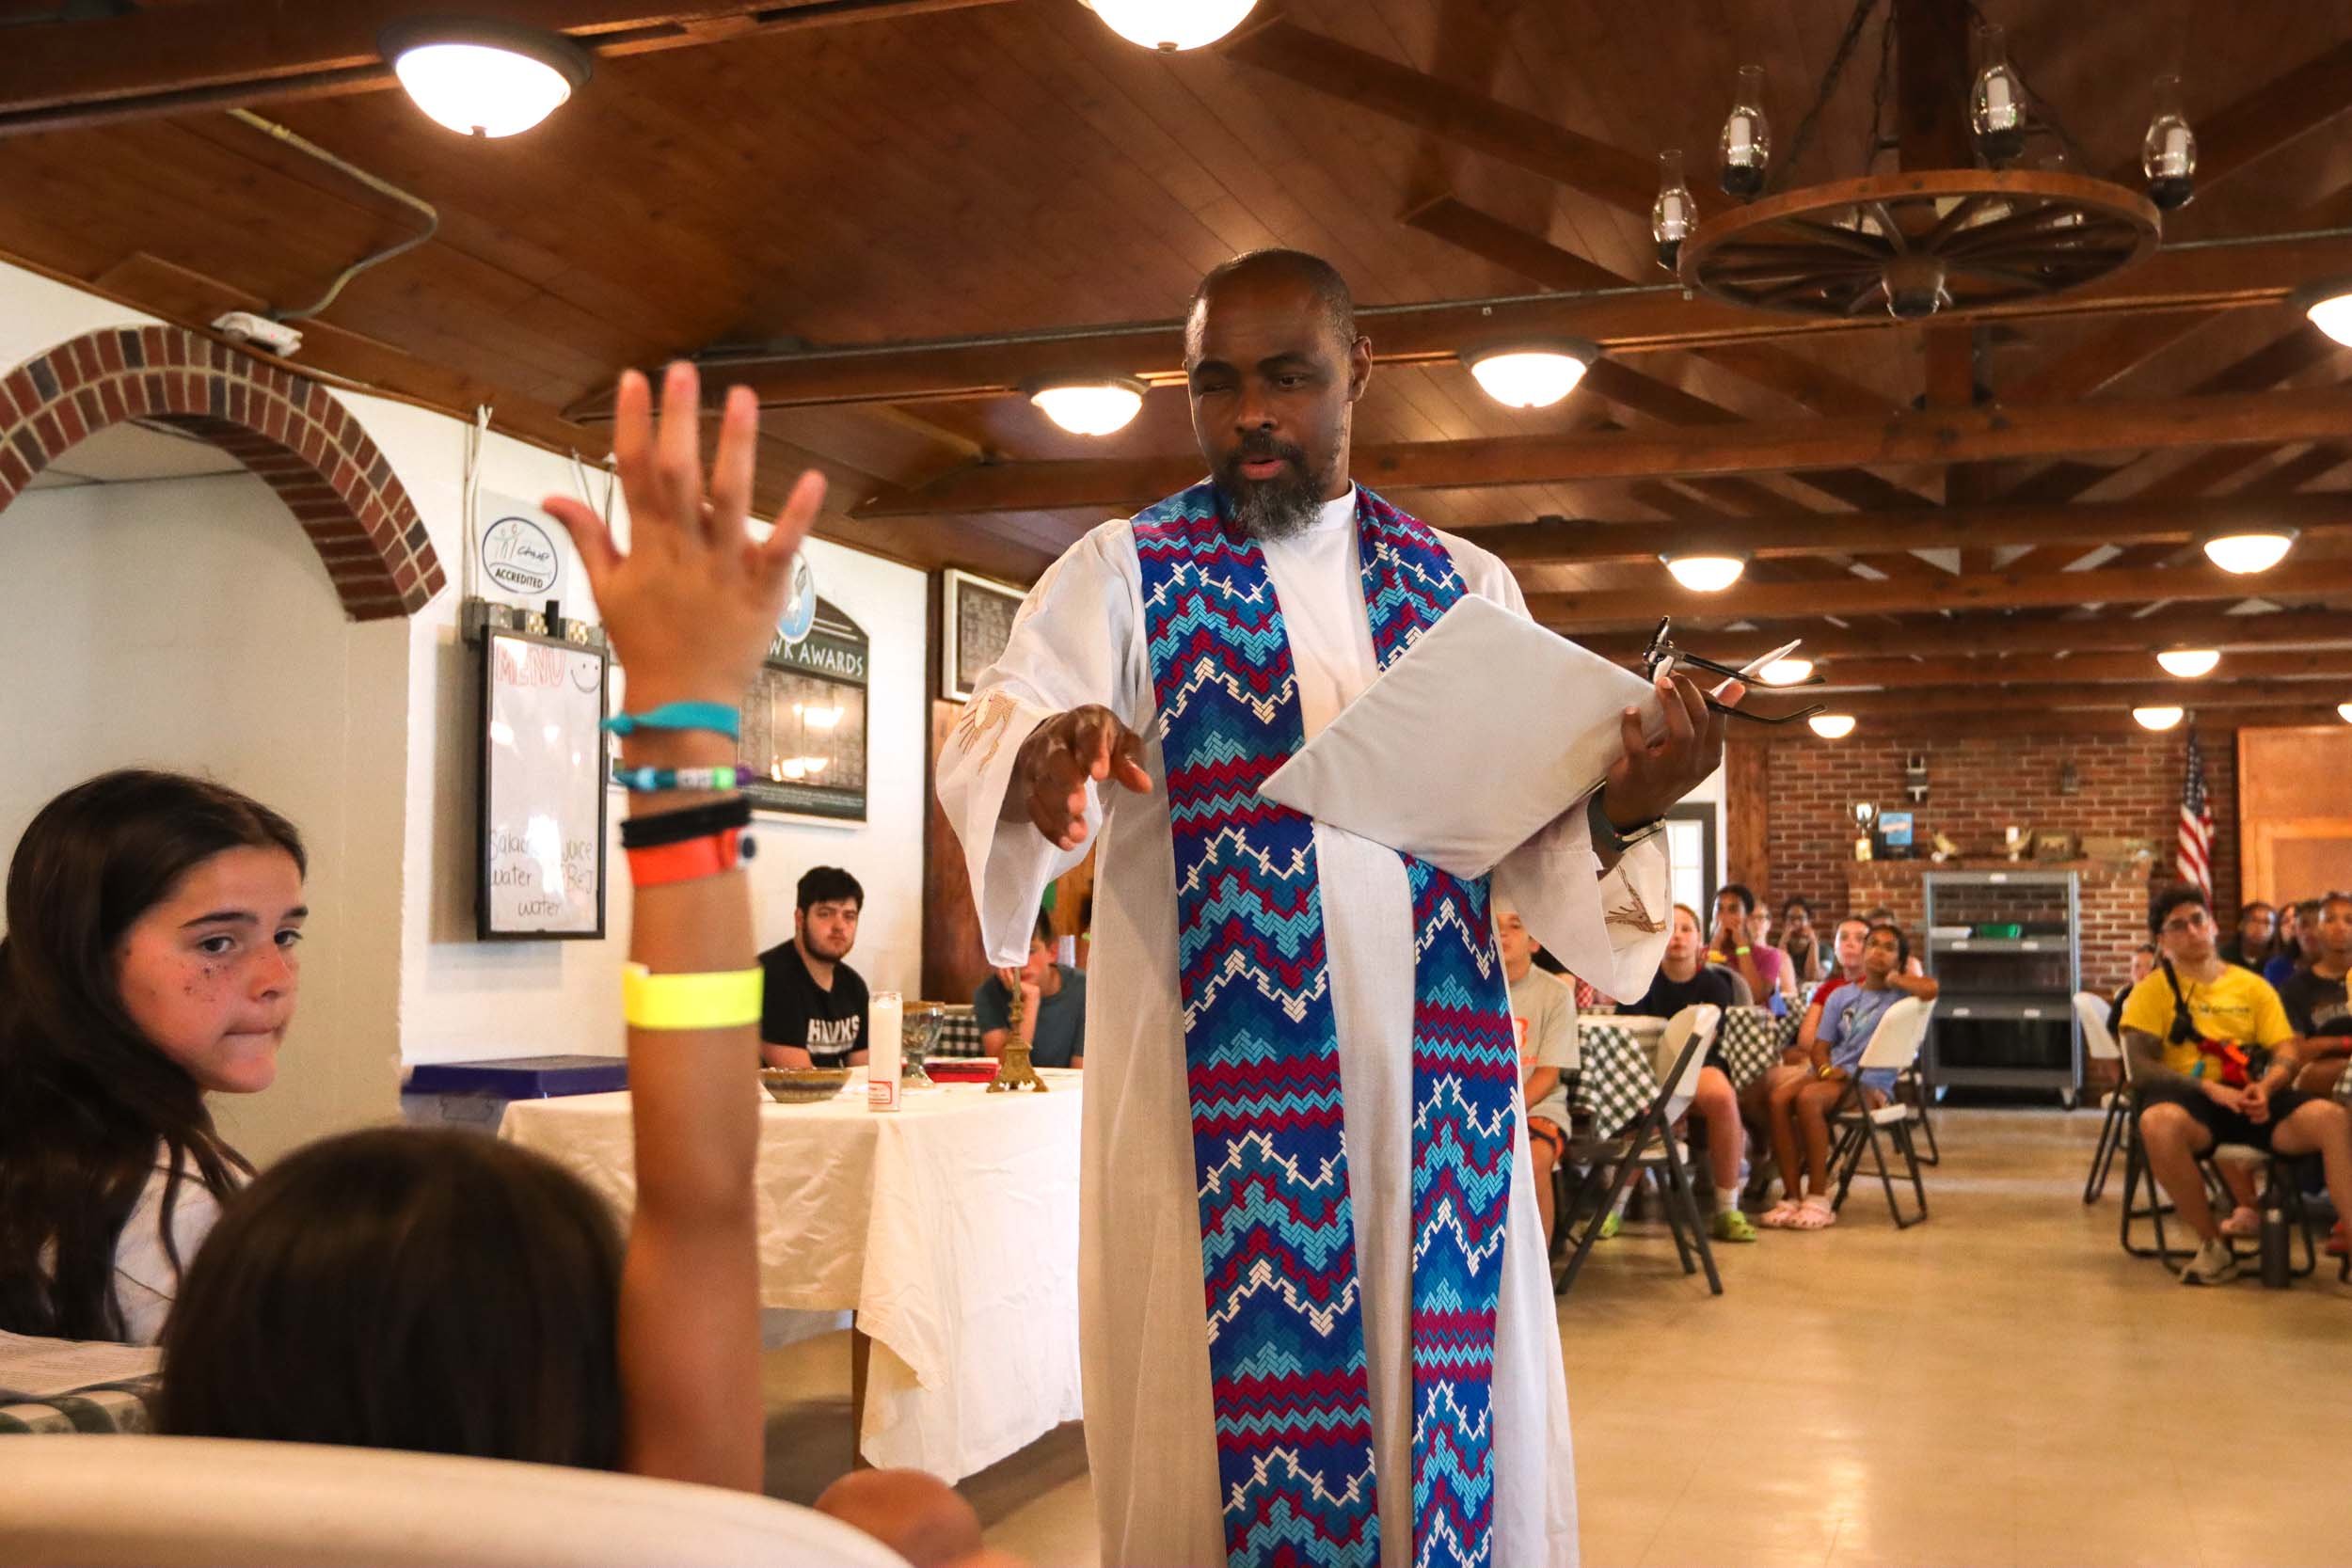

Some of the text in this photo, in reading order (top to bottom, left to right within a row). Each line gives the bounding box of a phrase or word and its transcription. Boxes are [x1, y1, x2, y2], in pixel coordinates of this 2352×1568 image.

[495, 567, 544, 589] ACCREDITED
[798, 642, 864, 677] AWARDS
[517, 895, 561, 918] water
